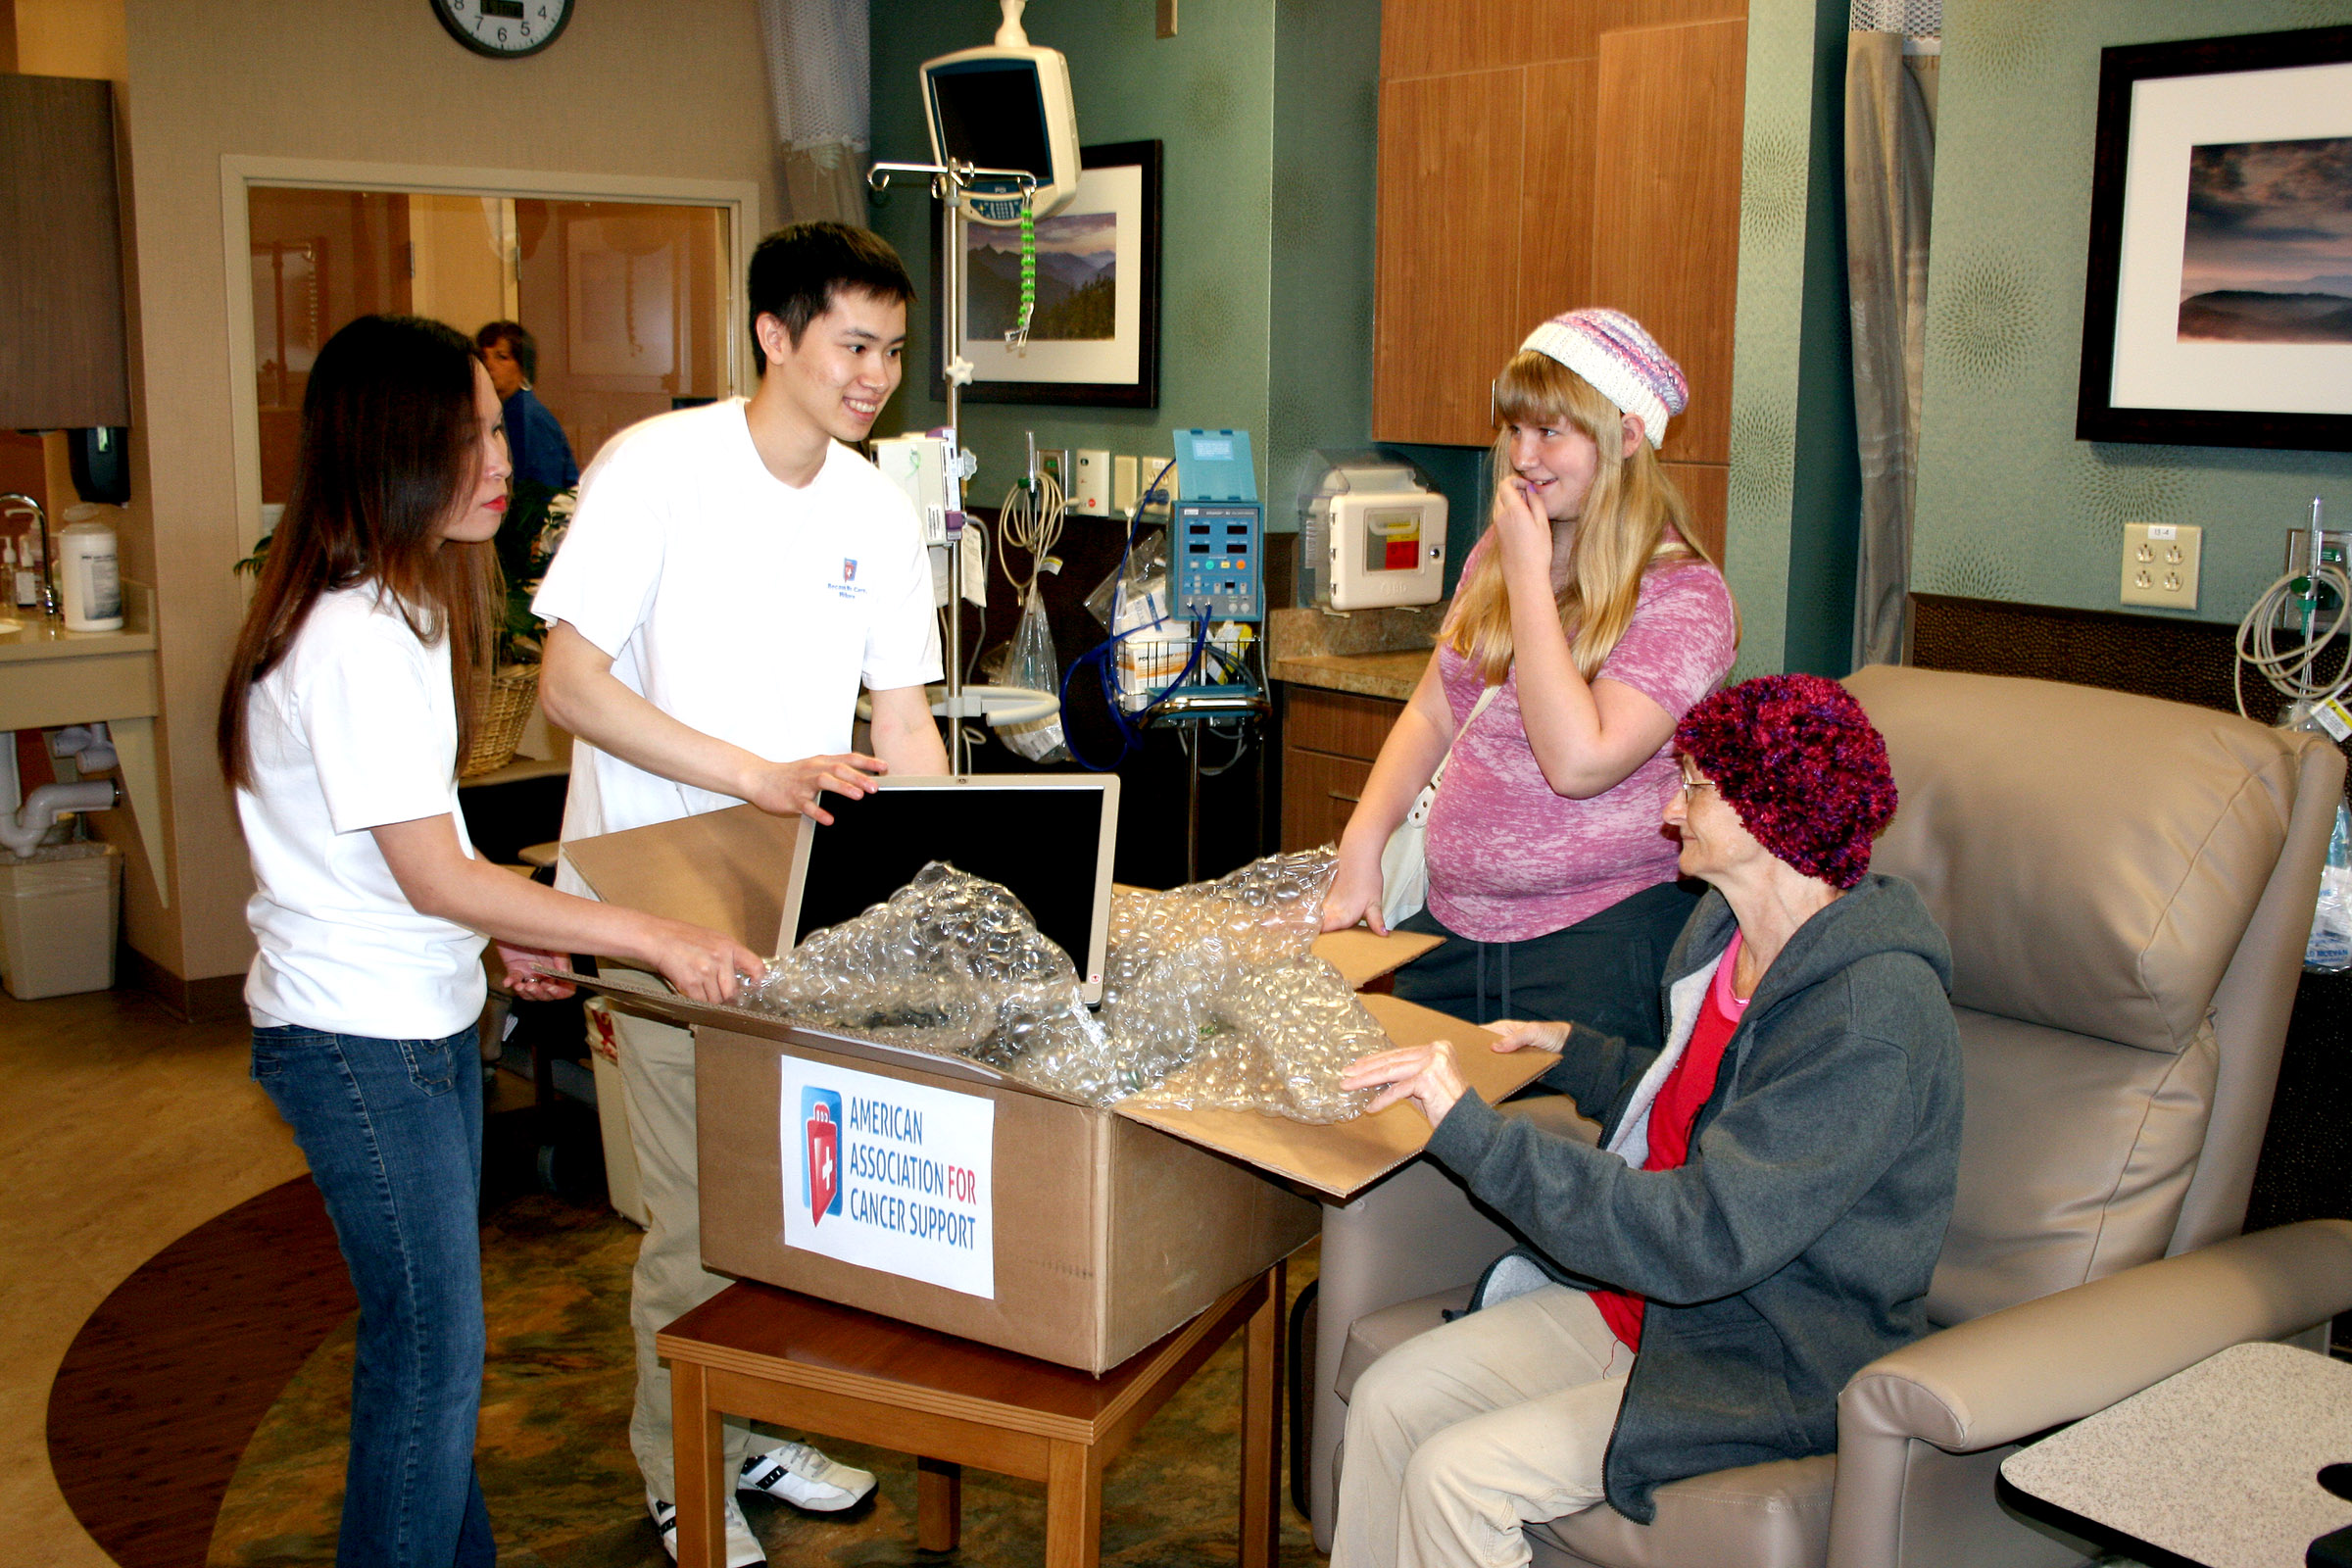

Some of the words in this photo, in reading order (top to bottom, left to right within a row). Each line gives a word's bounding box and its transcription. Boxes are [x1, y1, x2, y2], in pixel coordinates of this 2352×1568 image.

[454, 0, 465, 11] 8
[538, 5, 548, 21] 4
[474, 15, 484, 31] 7
[520, 21, 531, 36] 5
[497, 26, 508, 42] 6
[850, 1097, 923, 1146] AMERICAN
[850, 1143, 944, 1197] ASSOCIATION
[949, 1165, 976, 1205] FOR
[851, 1188, 906, 1234] CANCER
[909, 1201, 976, 1250] SUPPORT
